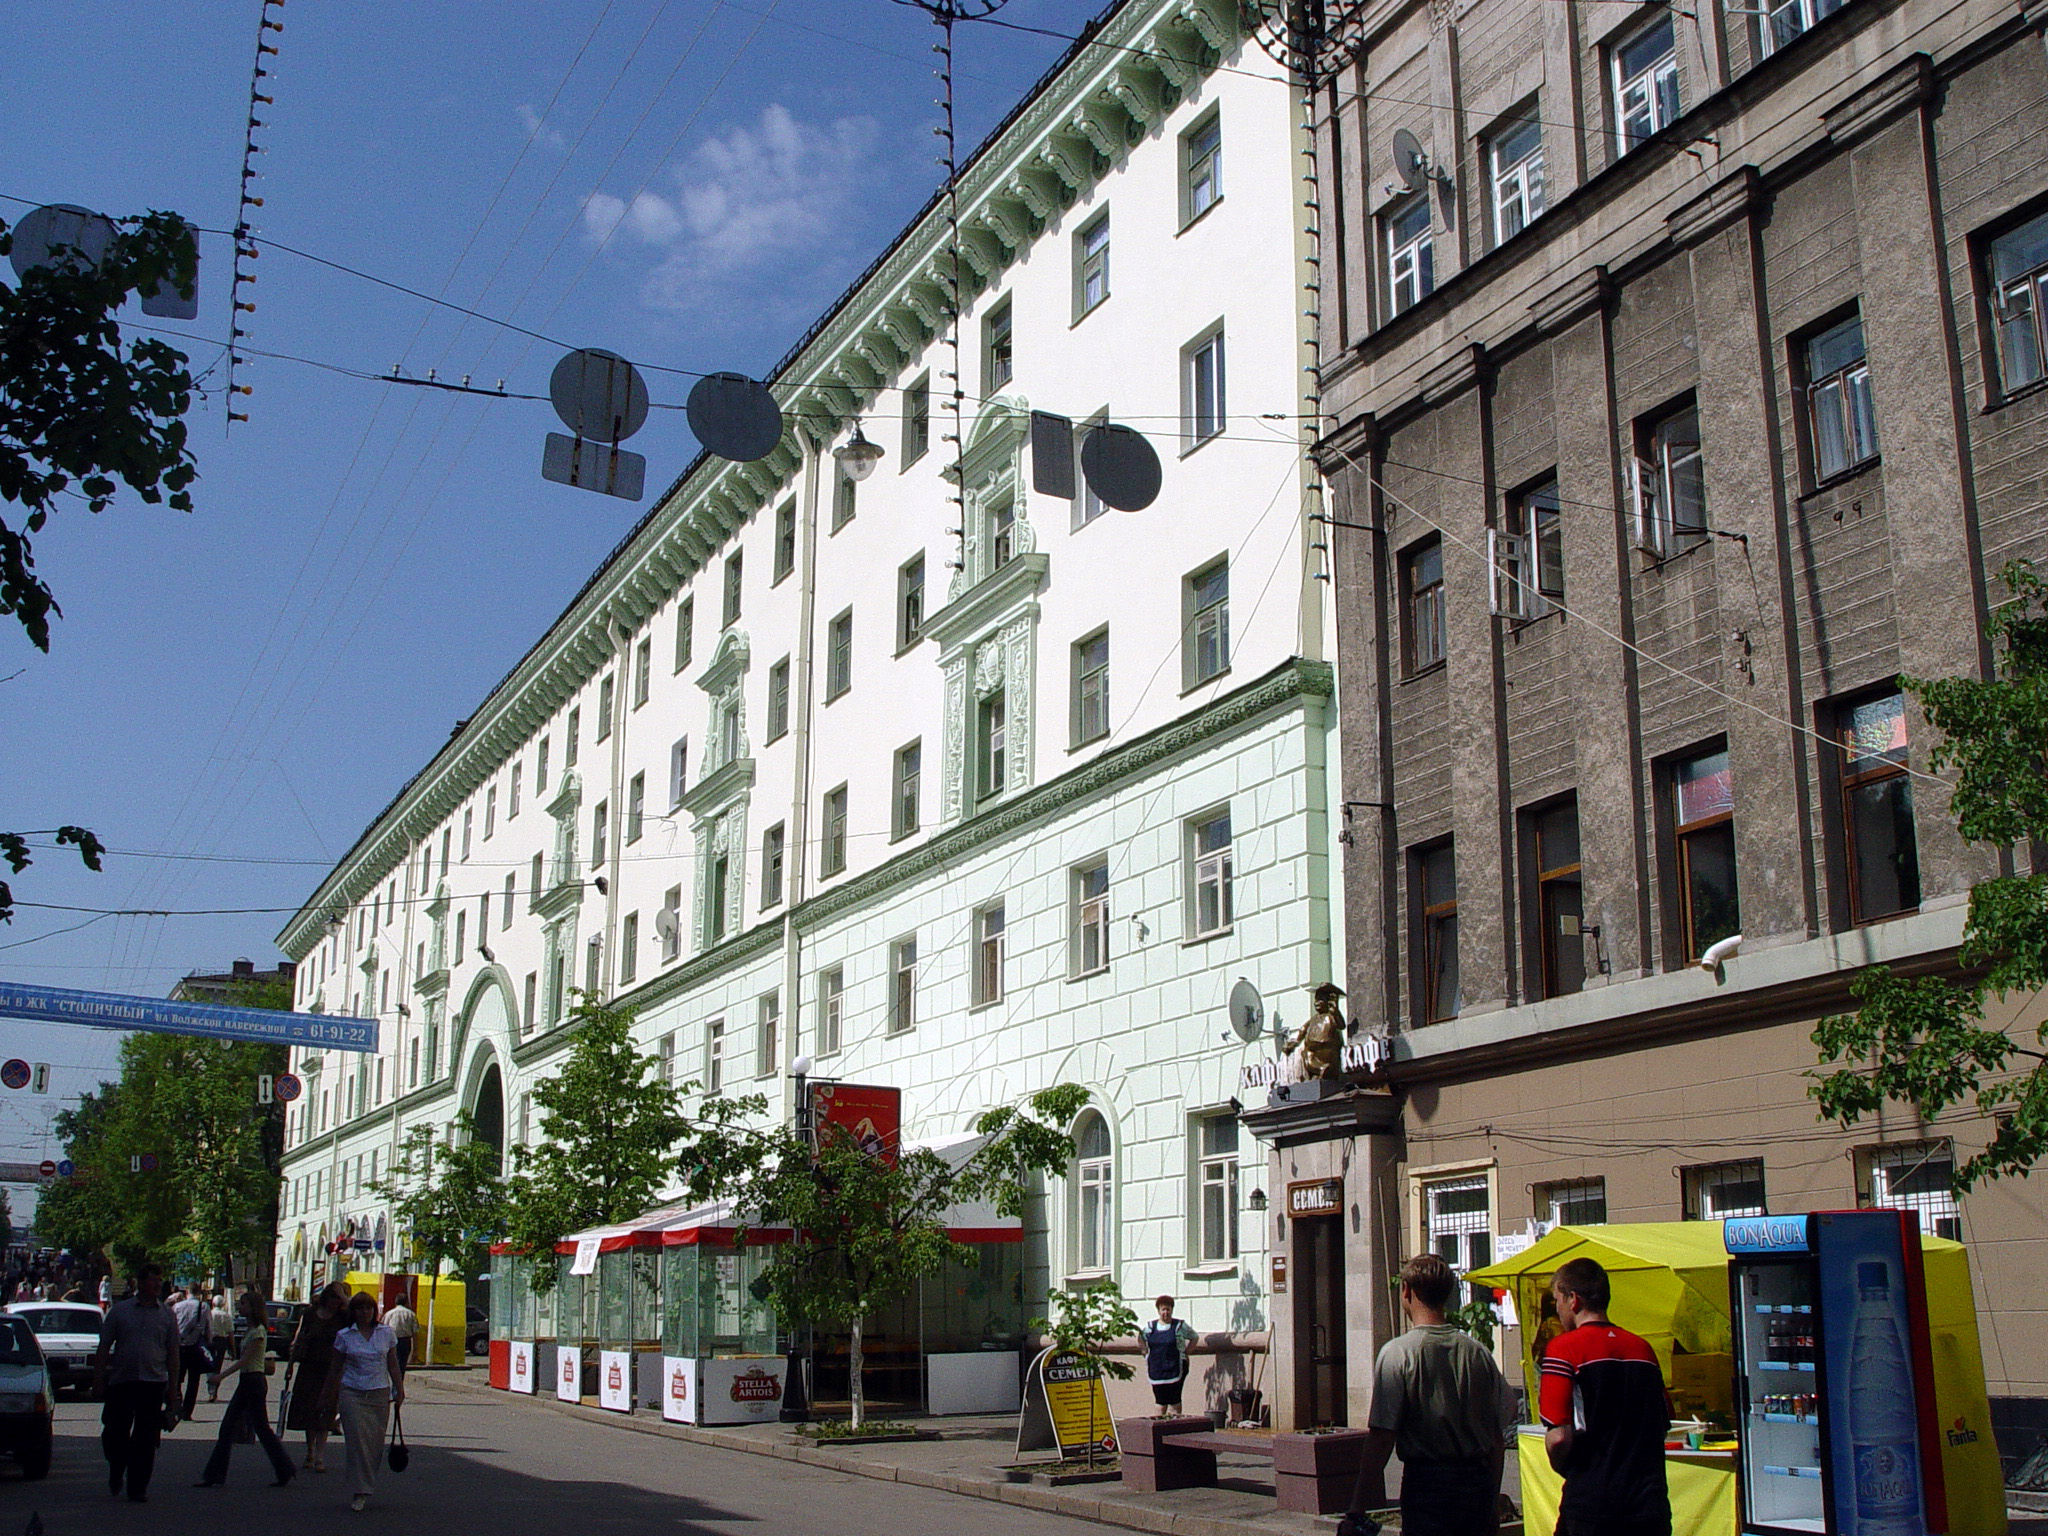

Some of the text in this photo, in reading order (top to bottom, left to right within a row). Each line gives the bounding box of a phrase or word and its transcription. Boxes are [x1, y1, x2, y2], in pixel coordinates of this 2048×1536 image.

[26, 998, 48, 1010] ЖК
[310, 1024, 366, 1042] 61-91-22
[1341, 1034, 1391, 1074] КАФЕ
[1728, 1220, 1806, 1248] BONAQUA
[738, 1379, 773, 1388] STELLA
[738, 1388, 775, 1397] ARTOIS
[1946, 1429, 1978, 1447] Fanta
